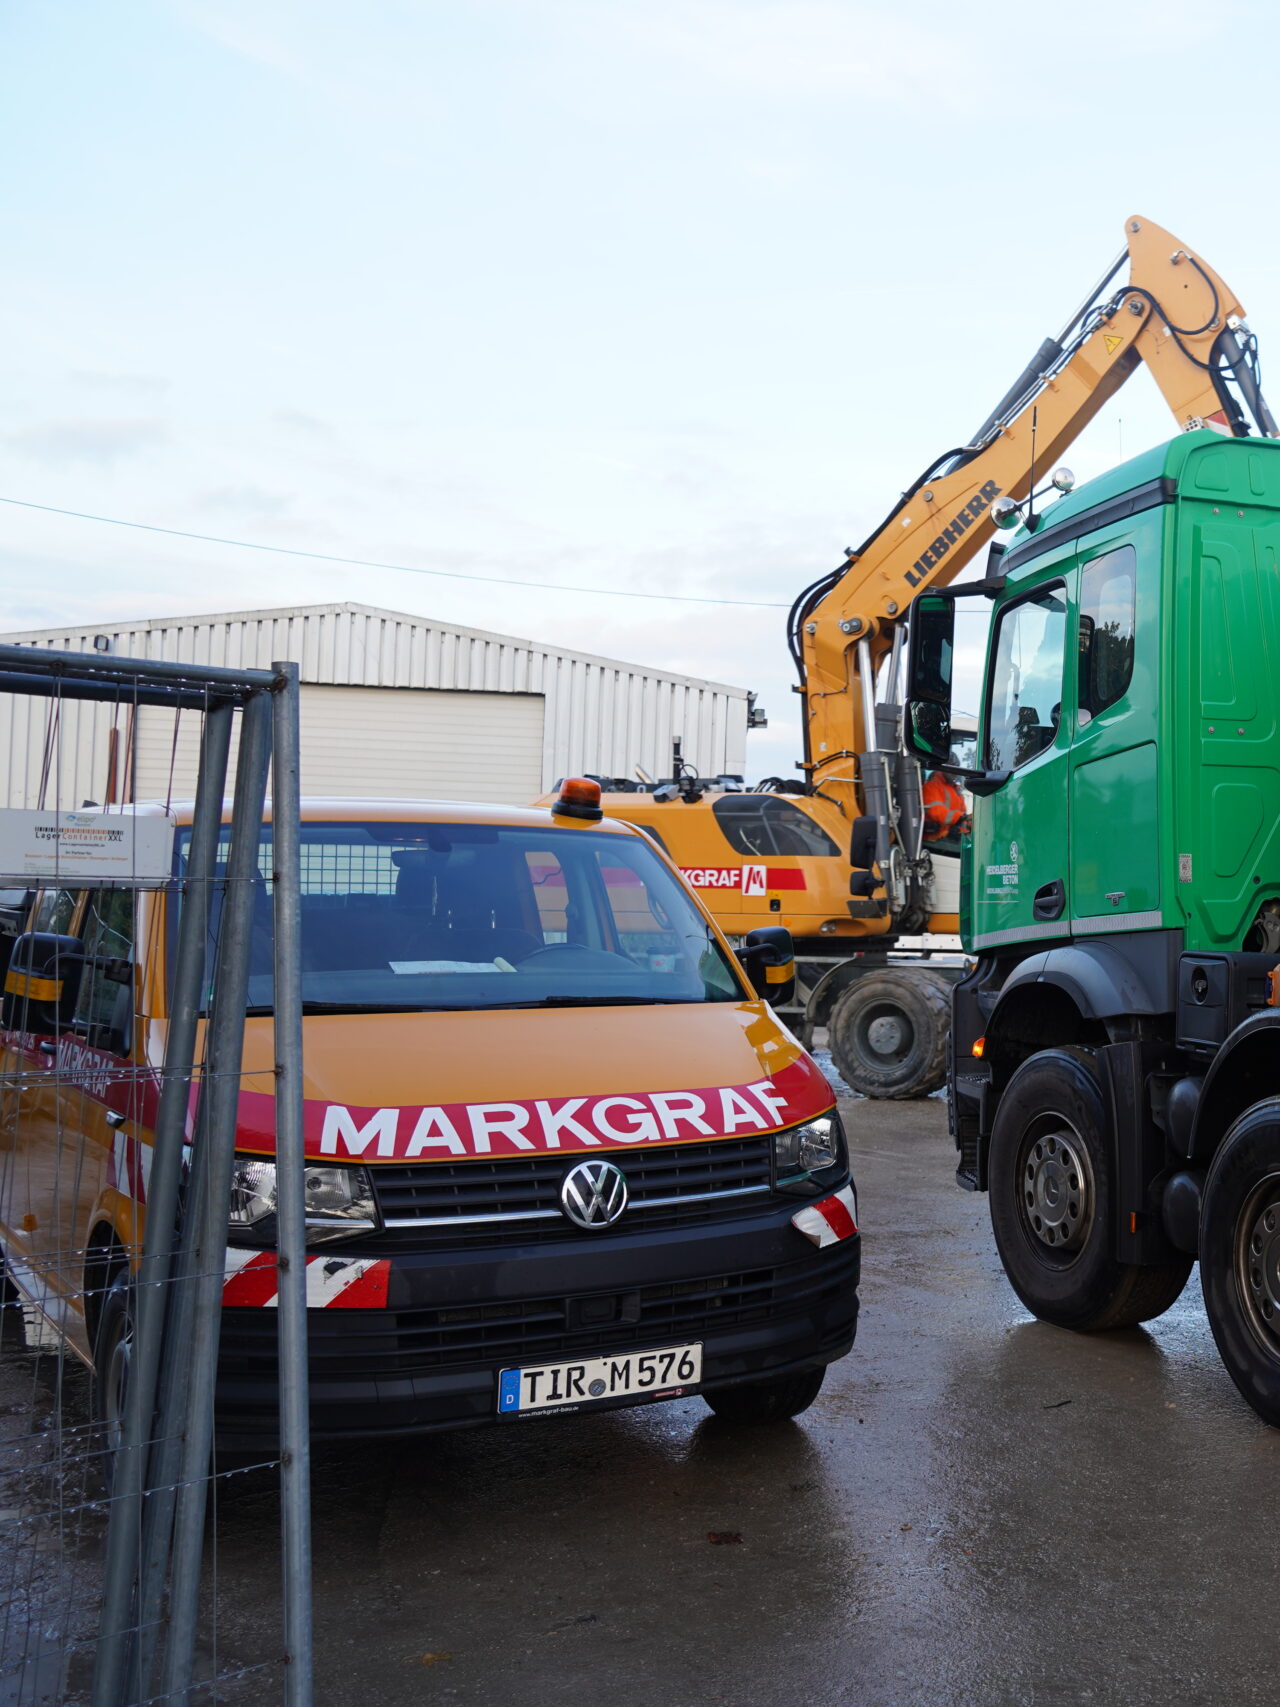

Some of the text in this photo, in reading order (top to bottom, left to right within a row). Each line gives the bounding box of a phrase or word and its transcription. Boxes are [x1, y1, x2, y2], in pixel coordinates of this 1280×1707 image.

[904, 480, 1002, 588] LIEBHERR
[1002, 875, 1019, 885] BETON
[319, 1081, 789, 1158] MARKGRAF
[523, 1350, 695, 1403] TIR M 576
[506, 1395, 514, 1405] D
[518, 1406, 580, 1418] www.markgraf-bau.de
